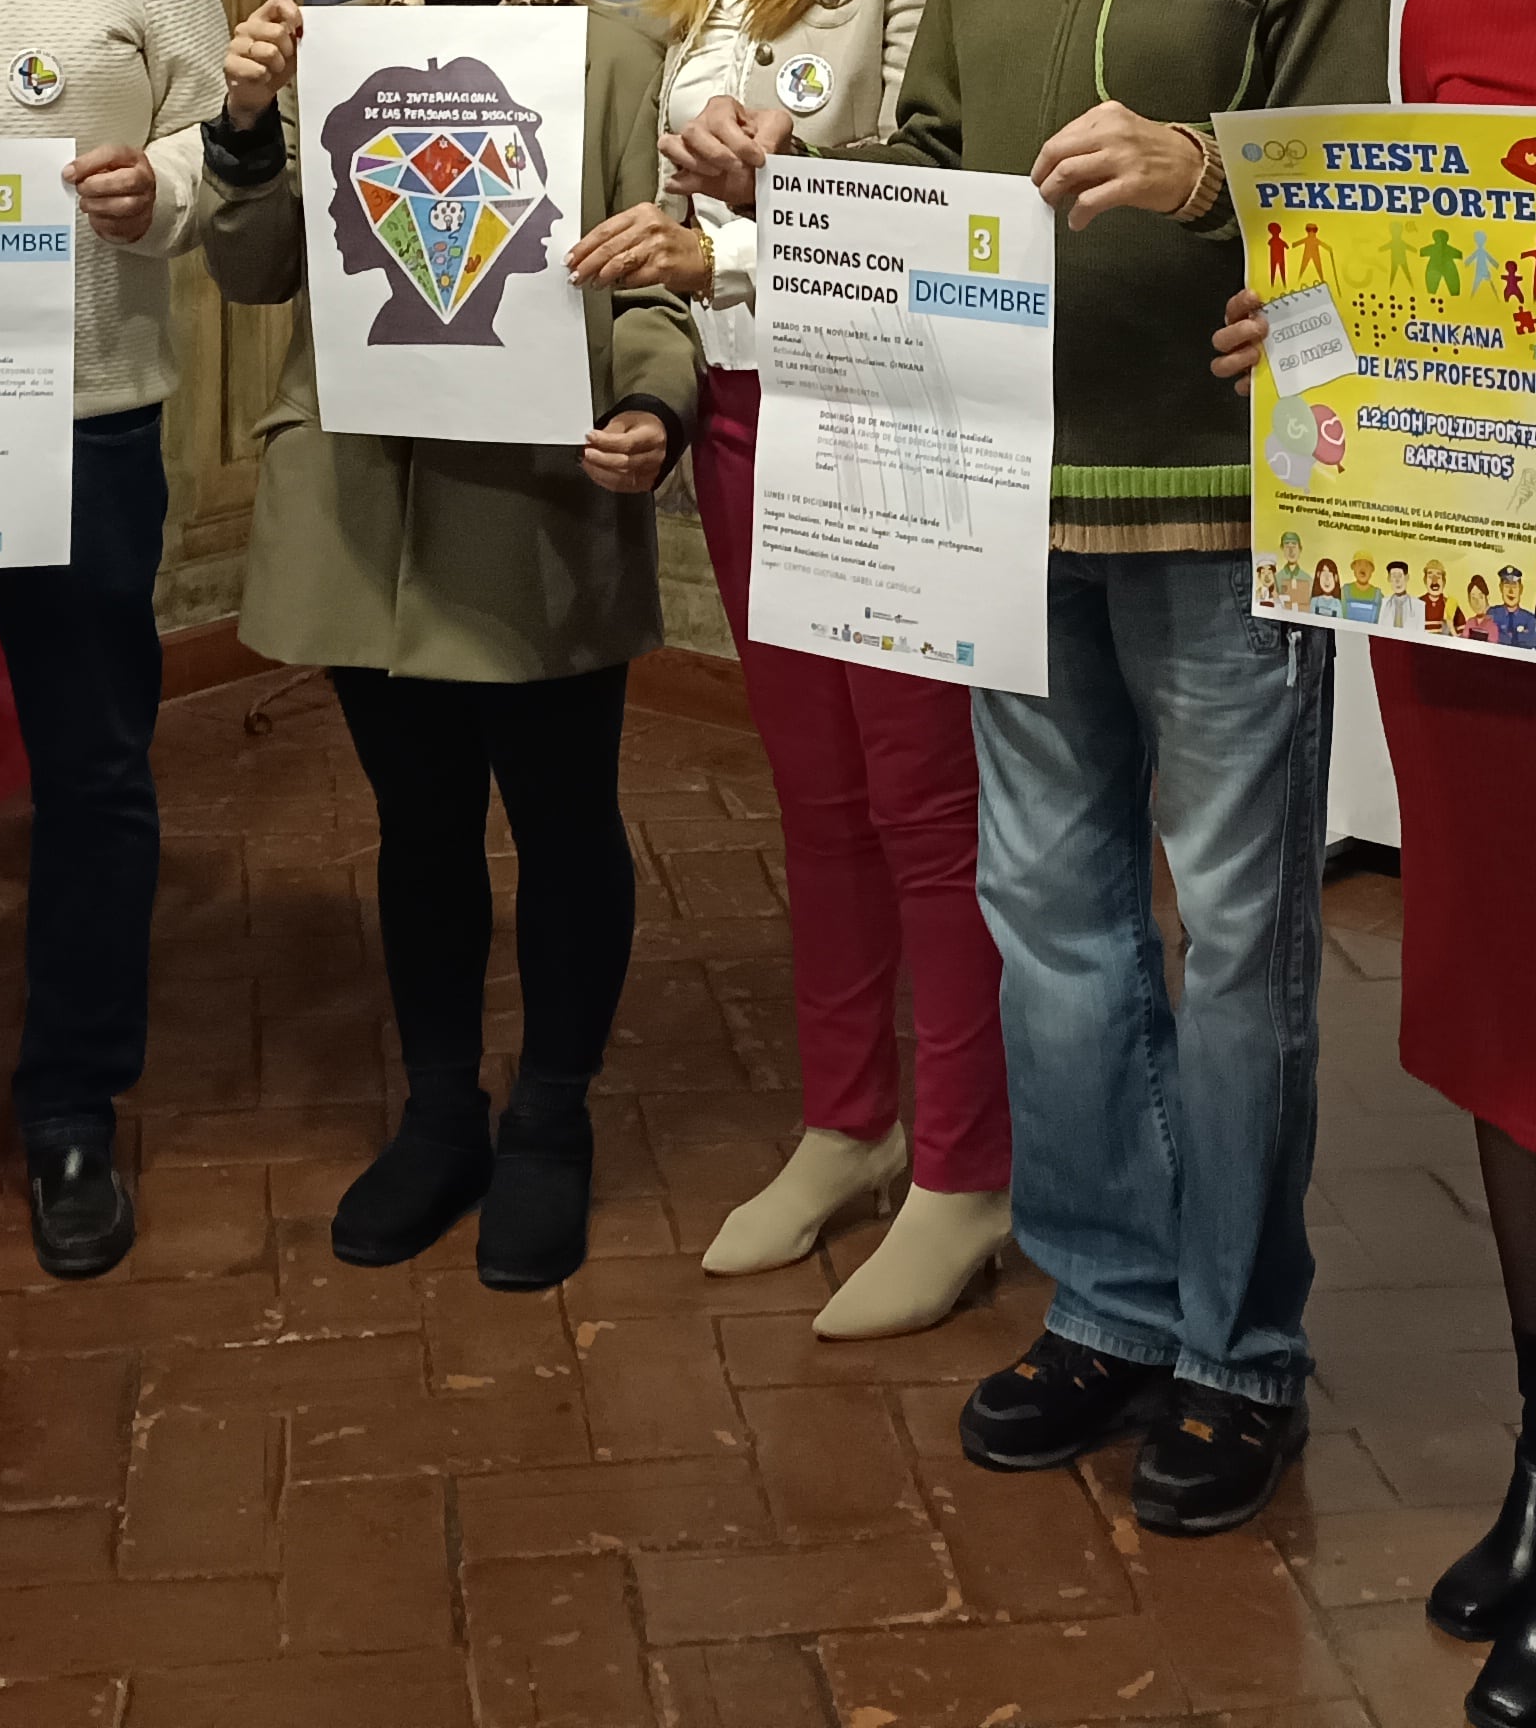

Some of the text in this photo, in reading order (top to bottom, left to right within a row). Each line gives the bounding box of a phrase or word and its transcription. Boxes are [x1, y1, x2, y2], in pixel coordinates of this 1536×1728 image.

[377, 91, 499, 103] DIA INTERNACIONAL
[364, 107, 379, 120] DE
[382, 107, 401, 120] LAS
[404, 108, 459, 121] PERSONAS
[1322, 143, 1469, 174] FIESTA
[772, 174, 949, 206] DIA INTERNACIONAL
[1256, 182, 1536, 221] PEKEDEPORTE
[773, 209, 830, 230] DE LAS
[773, 243, 904, 273] PERSONAS CON
[972, 228, 993, 261] 3
[772, 275, 898, 304] DISCAPACIDAD
[915, 280, 1046, 316] DICIEMBRE
[1404, 321, 1504, 349] GINKANA
[1357, 356, 1379, 377] DE
[1384, 358, 1419, 381] LAS
[1358, 408, 1424, 435] 12:00H
[1404, 445, 1514, 479] BARRIENTOS
[1318, 519, 1370, 533] DISCAPACIDAD
[1349, 500, 1409, 516] INTERNACIONAL
[1423, 510, 1432, 519] LA
[1434, 510, 1489, 525] DISCAPACIDAD
